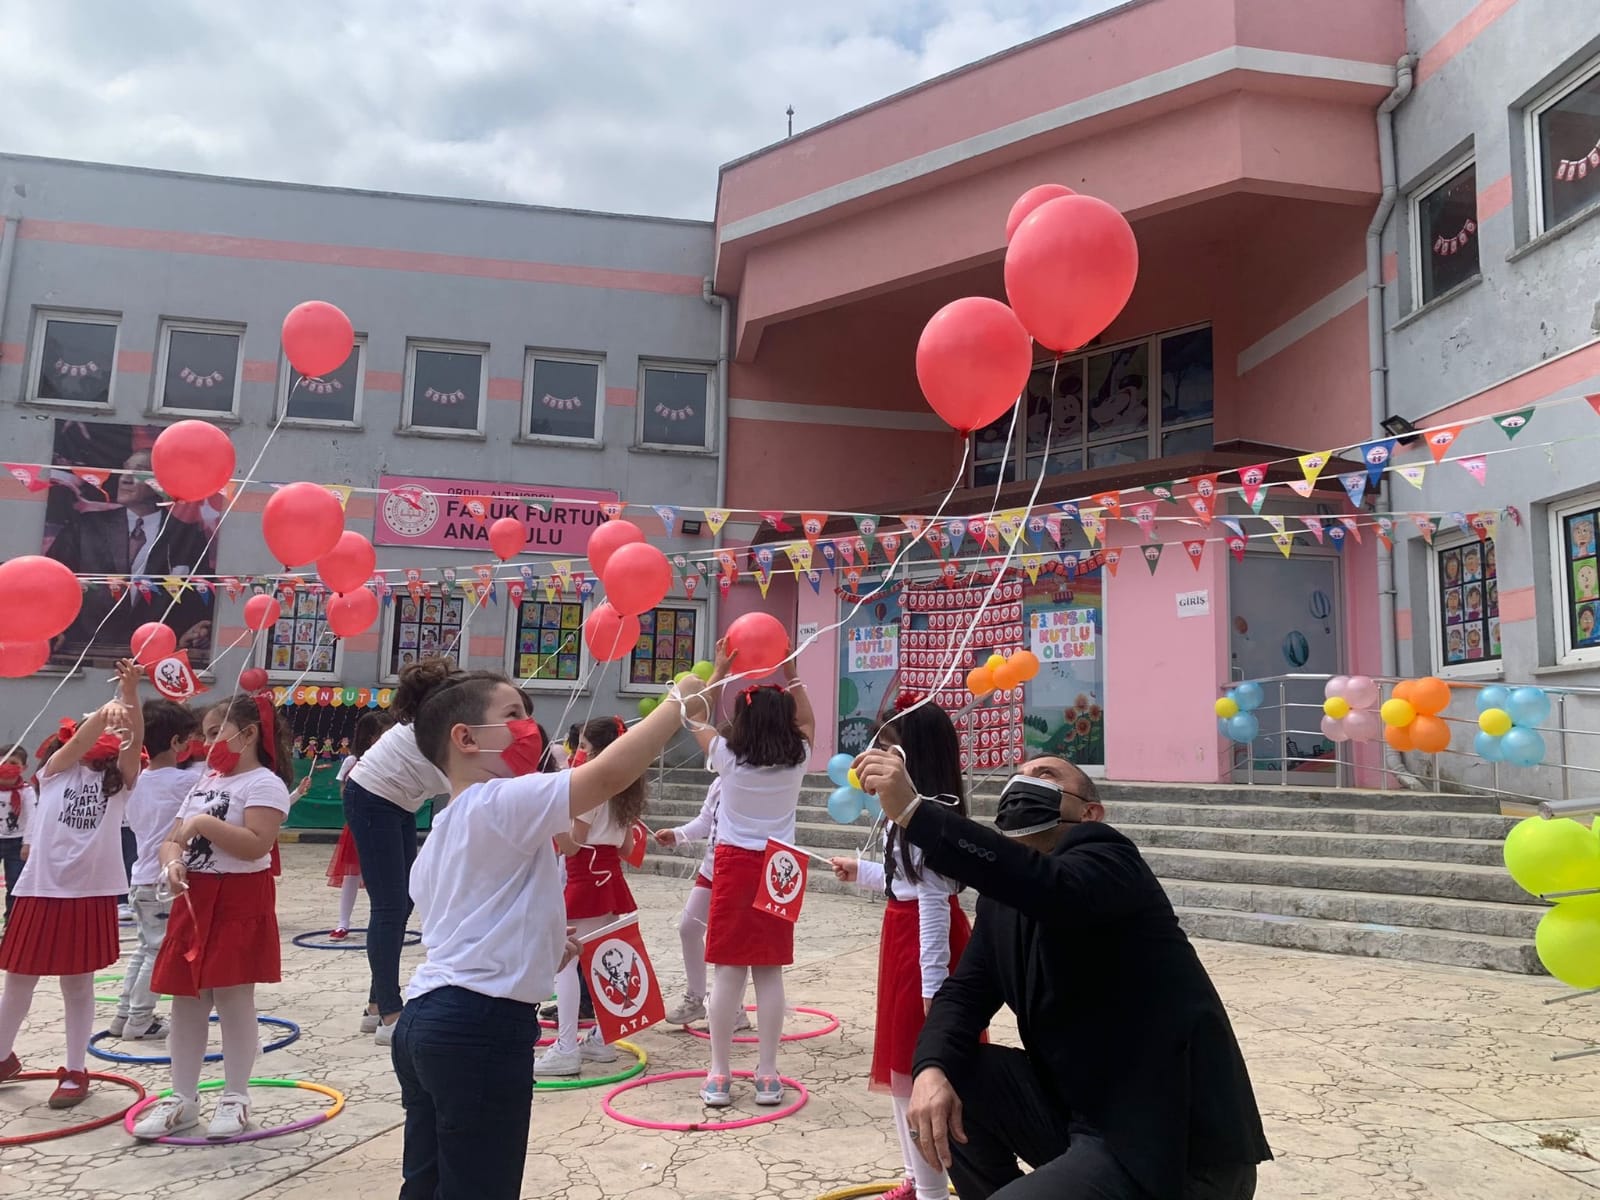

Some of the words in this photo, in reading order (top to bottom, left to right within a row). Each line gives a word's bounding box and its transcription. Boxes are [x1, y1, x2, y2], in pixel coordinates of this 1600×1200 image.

[446, 500, 519, 520] FAUK
[443, 522, 563, 545] ANAULU
[1030, 614, 1048, 629] 23
[1039, 626, 1091, 643] KUTLU
[855, 639, 893, 654] KUTLU
[1043, 642, 1095, 659] OLSUN
[855, 655, 893, 669] OLSUN
[764, 902, 788, 917] ATA
[619, 1014, 650, 1036] ATA
